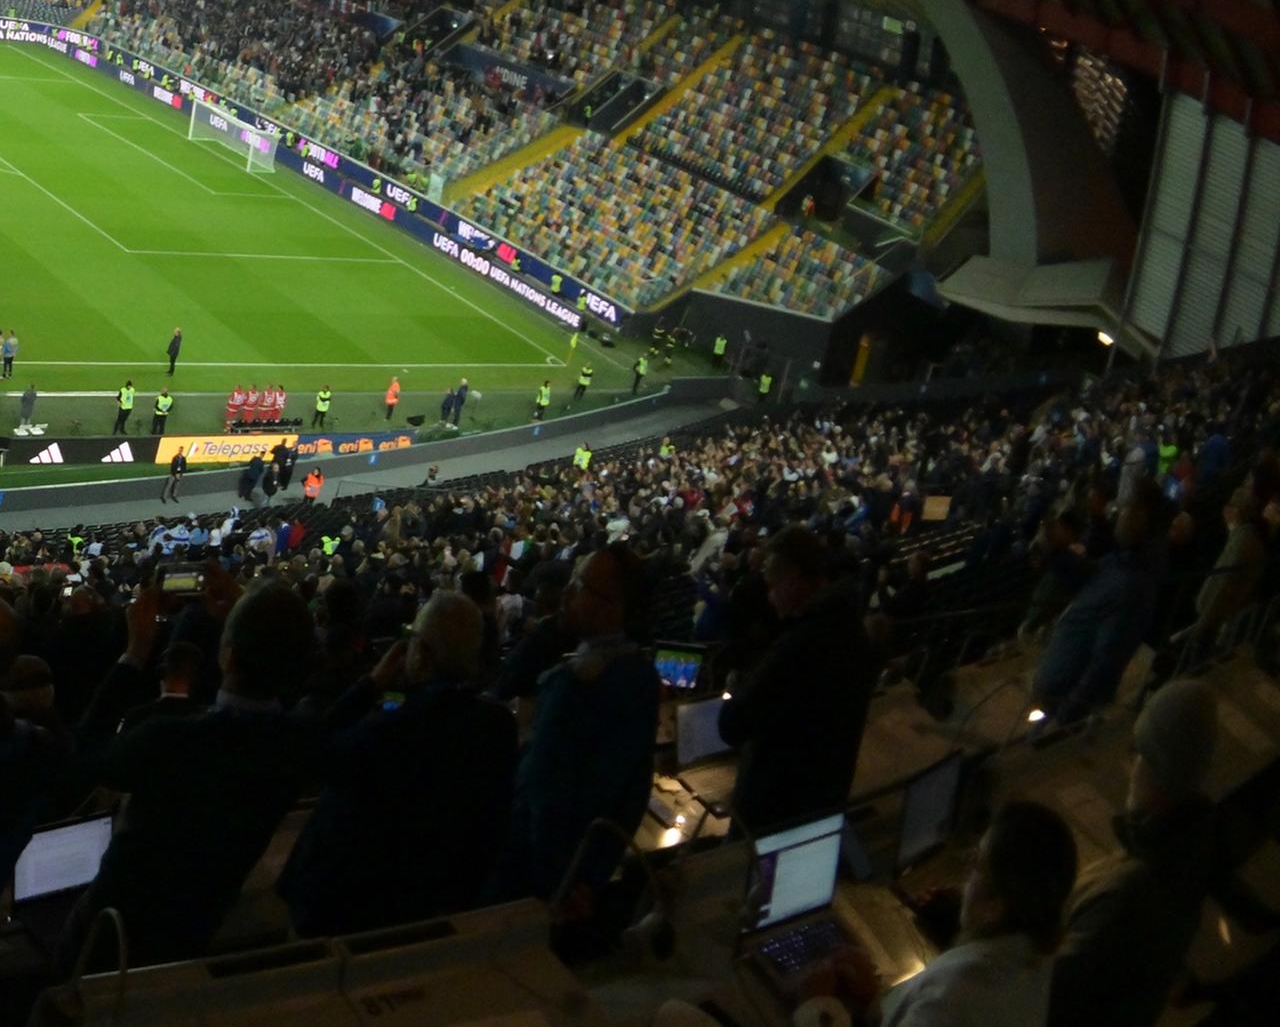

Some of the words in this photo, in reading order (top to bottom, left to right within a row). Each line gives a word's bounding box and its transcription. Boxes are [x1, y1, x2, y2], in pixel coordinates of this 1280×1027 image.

[5, 30, 48, 48] NATIONS
[302, 162, 325, 184] UEFA
[433, 232, 460, 259] UEFA
[460, 248, 490, 276] 00:00
[490, 265, 511, 287] UEFA
[510, 277, 547, 308] NATIONS
[545, 299, 582, 329] LEAGUE
[201, 440, 269, 459] Telepass
